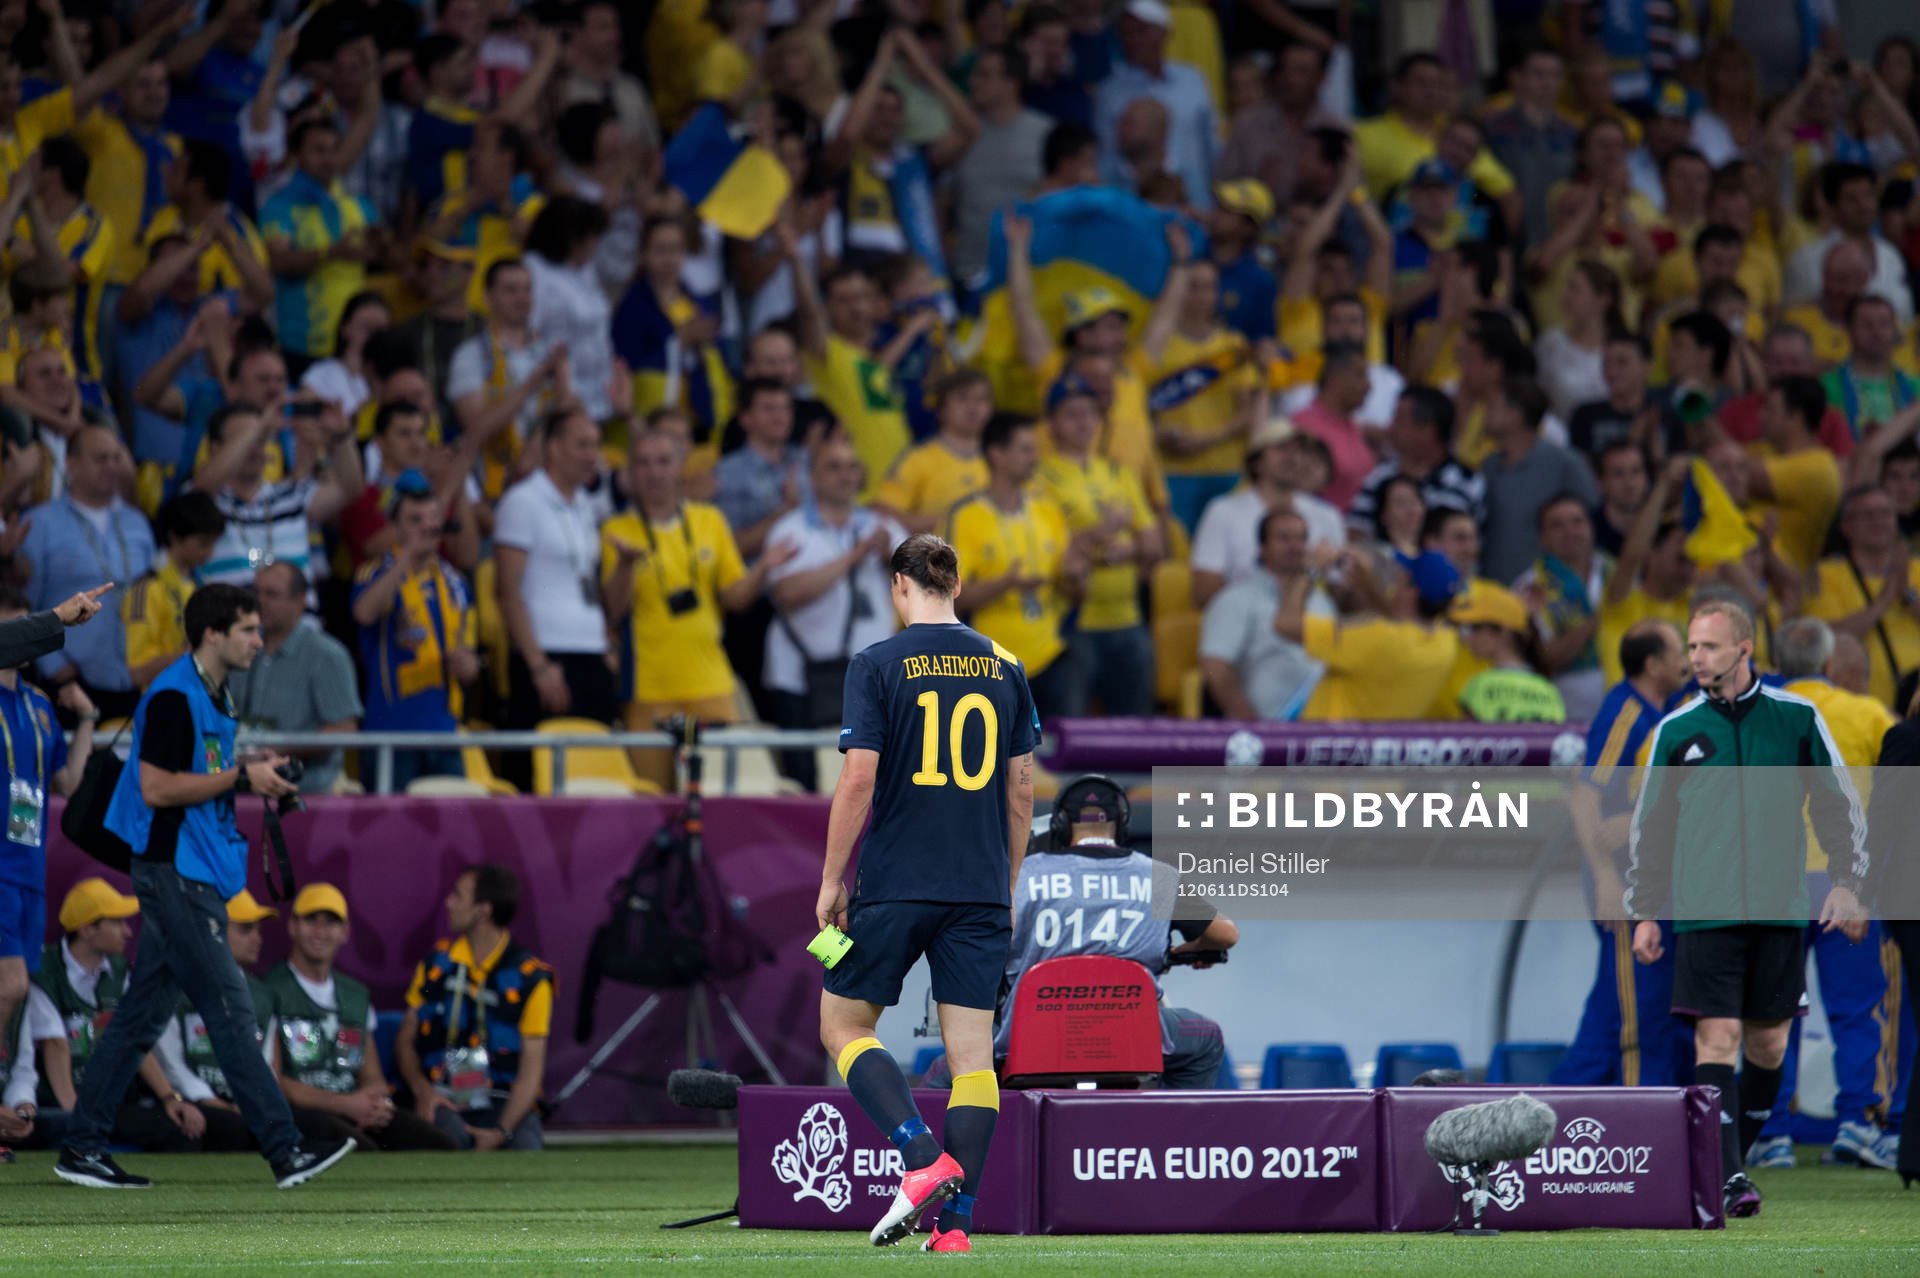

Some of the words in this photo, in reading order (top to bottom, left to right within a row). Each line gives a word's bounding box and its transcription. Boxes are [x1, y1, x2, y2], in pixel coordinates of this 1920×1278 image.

[903, 654, 1004, 681] IBRAHIMOVIĆ
[912, 690, 999, 790] 10
[1028, 873, 1073, 901] HB
[1082, 875, 1152, 904] FILM
[1035, 908, 1145, 949] 0147
[1037, 985, 1142, 999] ORBITER
[1065, 1002, 1141, 1011] SUPERFLAT
[1566, 1122, 1602, 1141] UEFA
[853, 1149, 906, 1178] EUR
[1073, 1148, 1157, 1180] UEFA
[1165, 1147, 1254, 1179] EURO
[1542, 1181, 1636, 1194] POLAND-UKRAINE
